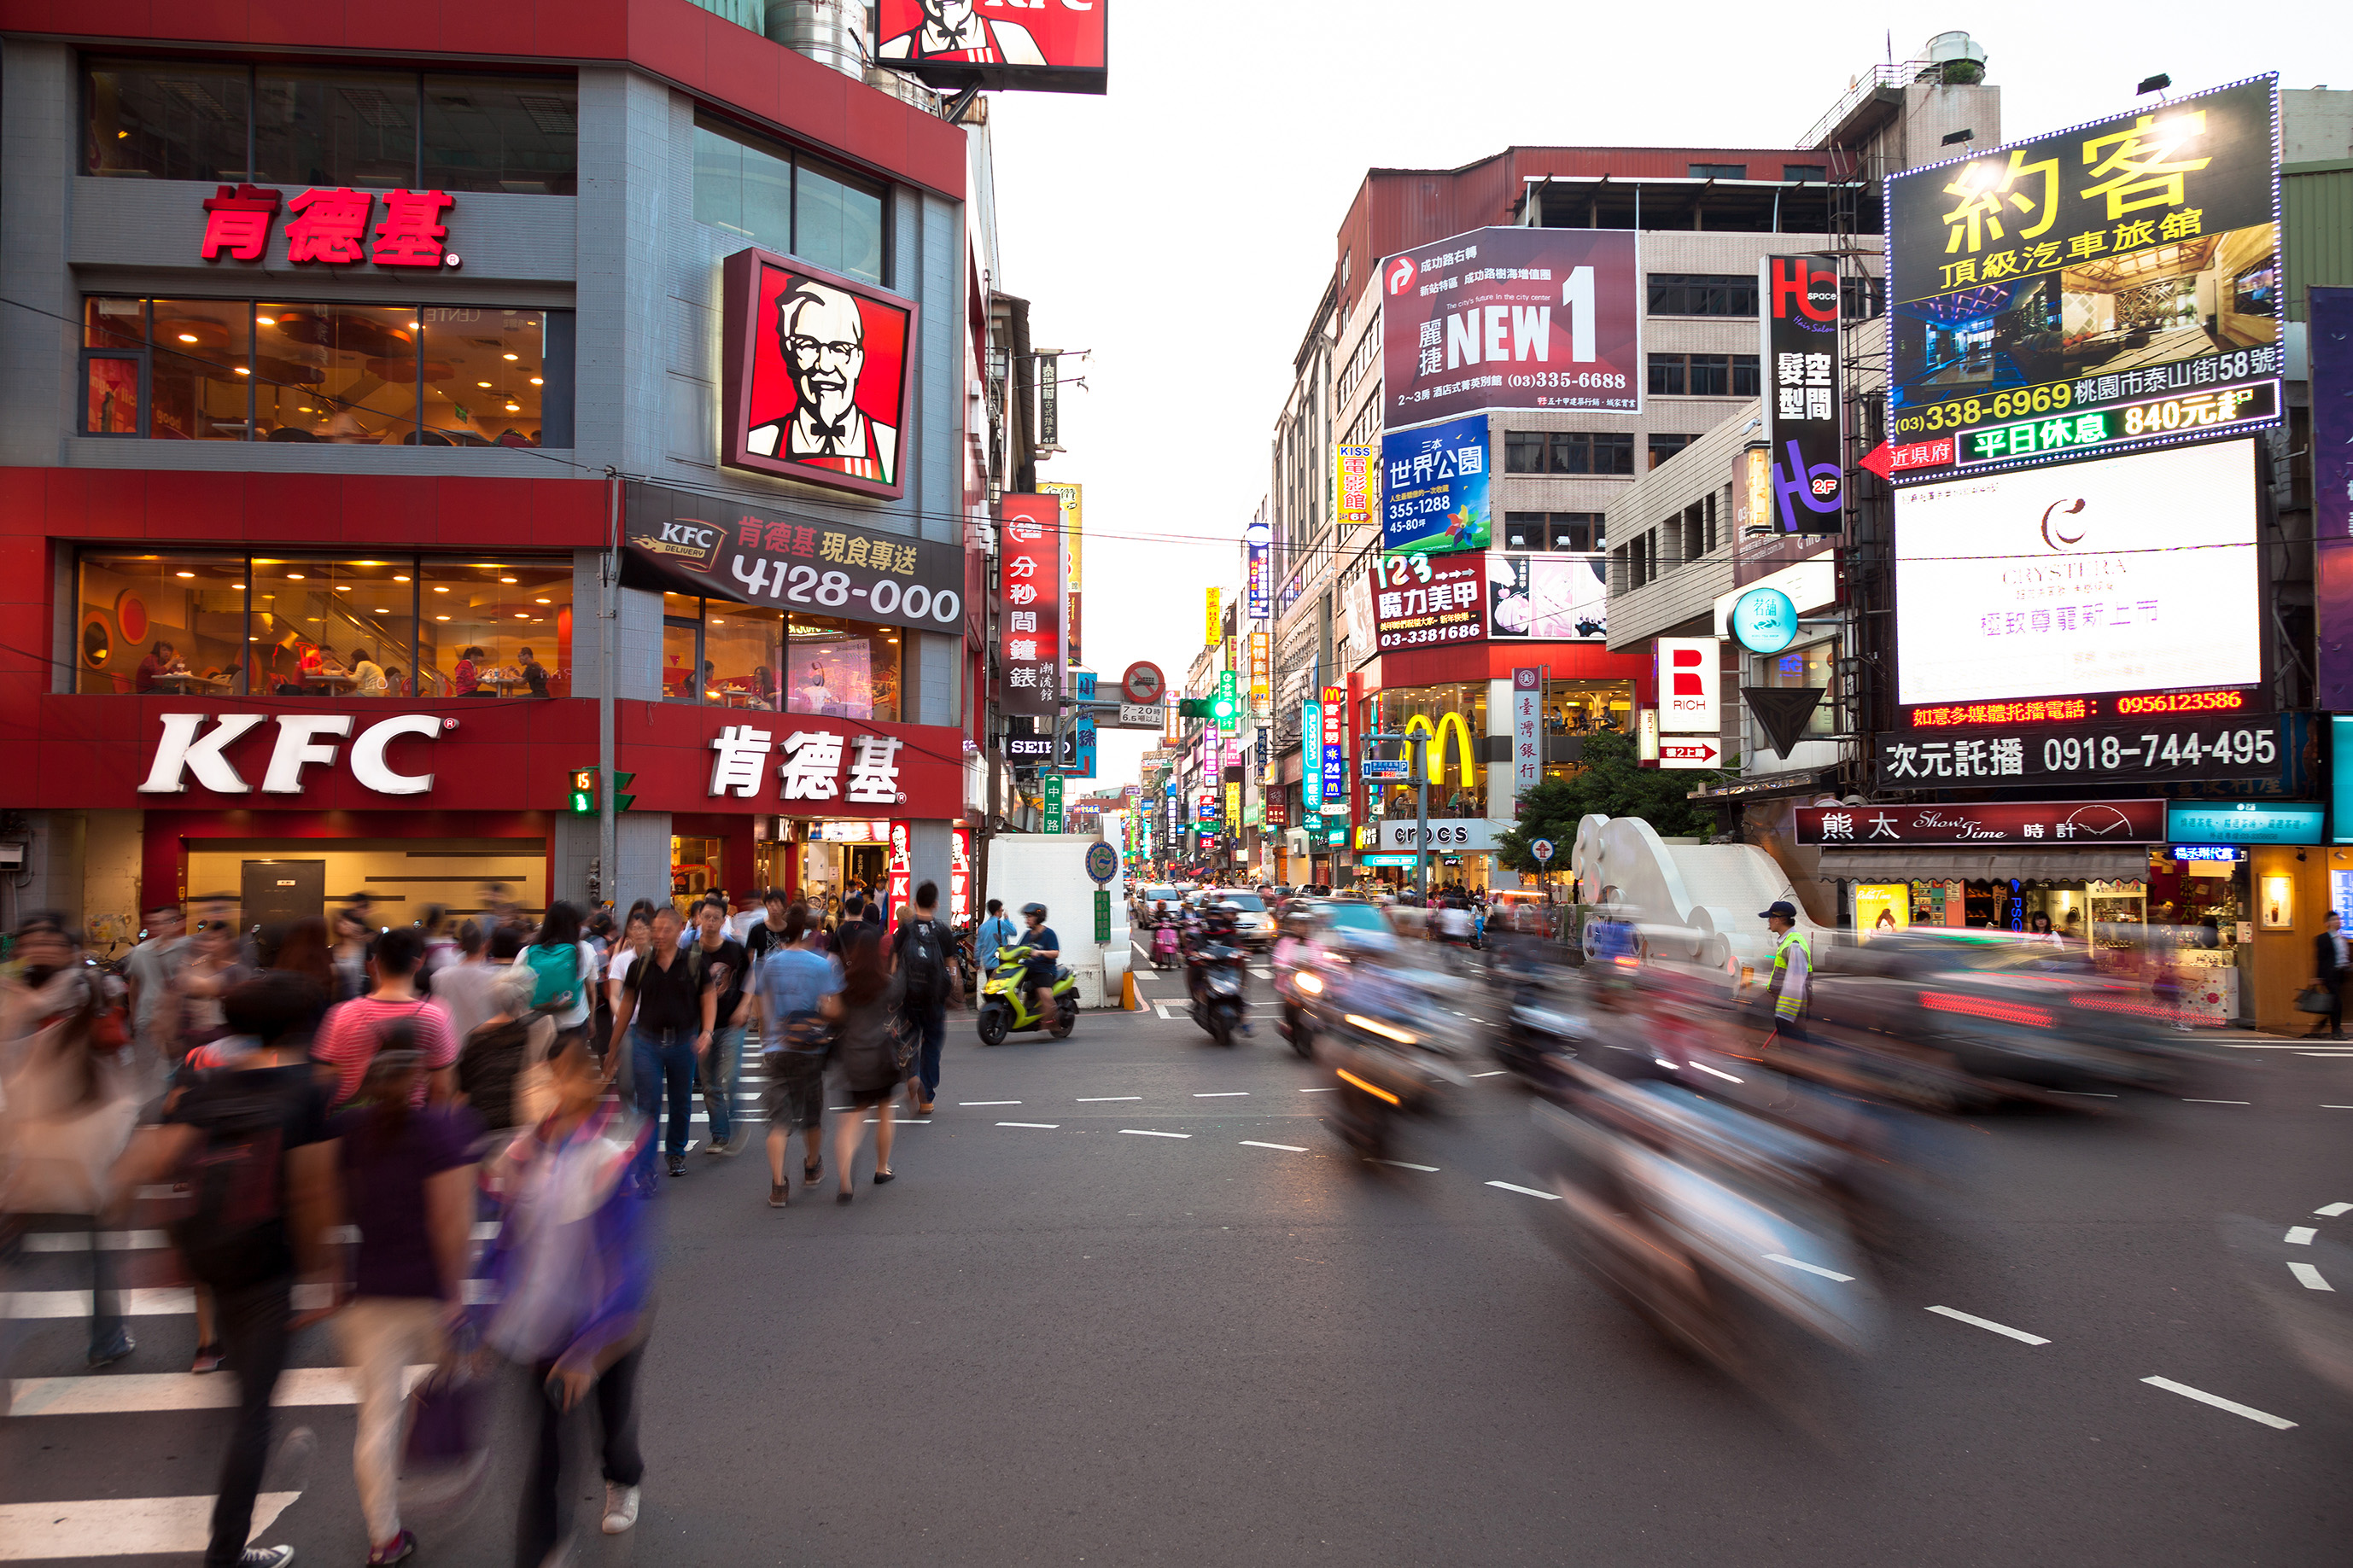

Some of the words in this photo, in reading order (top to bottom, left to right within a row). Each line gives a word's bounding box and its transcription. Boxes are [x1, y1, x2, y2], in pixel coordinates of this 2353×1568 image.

[1941, 109, 2214, 254] 約客
[201, 184, 455, 268] 肯德基
[1420, 245, 1477, 273] 成功路右轉
[1419, 276, 1458, 297] 新站特區
[1458, 298, 1474, 307] city's
[1562, 266, 1596, 362] 1
[1419, 318, 1443, 377] 麗捷
[1447, 305, 1550, 370] NEW
[1508, 371, 1626, 390] (03)335-6688
[2074, 348, 2276, 405] 桃園市泰山街58號
[156, 410, 182, 428] good
[1895, 383, 2072, 435] (03)338-6969
[1340, 447, 1371, 457] KISS
[1422, 438, 1443, 453] 三本
[1975, 414, 2107, 459] 平日休息
[1344, 458, 1367, 510] 電影館
[1390, 446, 1483, 489] 世界公園
[1812, 480, 1836, 495] 2F
[1390, 495, 1451, 520] 355-1288
[1390, 519, 1426, 533] 45-80坪
[659, 522, 713, 548] KFC
[664, 545, 704, 557] DELIVERY
[738, 516, 817, 558] 肯德基
[820, 531, 918, 576] 現食專送
[732, 554, 960, 623] 4128-000
[1376, 551, 1432, 589] 123
[1379, 580, 1478, 620] 魔力美甲
[1010, 556, 1038, 688] 分秒間鐘錶
[1381, 623, 1480, 646] 03-3381686
[1039, 662, 1054, 702] 潮流館
[1122, 714, 1160, 723] 6.5噸以上
[1673, 700, 1706, 710] RICH
[2118, 691, 2243, 714] 0956123586
[1308, 714, 1317, 761] watsons
[1324, 703, 1339, 744] 麥當勞
[1519, 697, 1537, 778] 臺灣銀行
[137, 714, 445, 795] KFC
[709, 725, 902, 803] 肯德基
[1324, 762, 1340, 773] 24
[1886, 737, 2023, 778] 次元託播
[2043, 730, 2276, 772] 0918-744-495
[577, 772, 589, 790] 15
[1047, 786, 1060, 831] 中正路
[1821, 812, 1900, 840] 熊太
[1912, 810, 1964, 829] Show
[1956, 821, 2009, 840] Time
[779, 817, 794, 841] KFC
[2023, 823, 2077, 839] 時計
